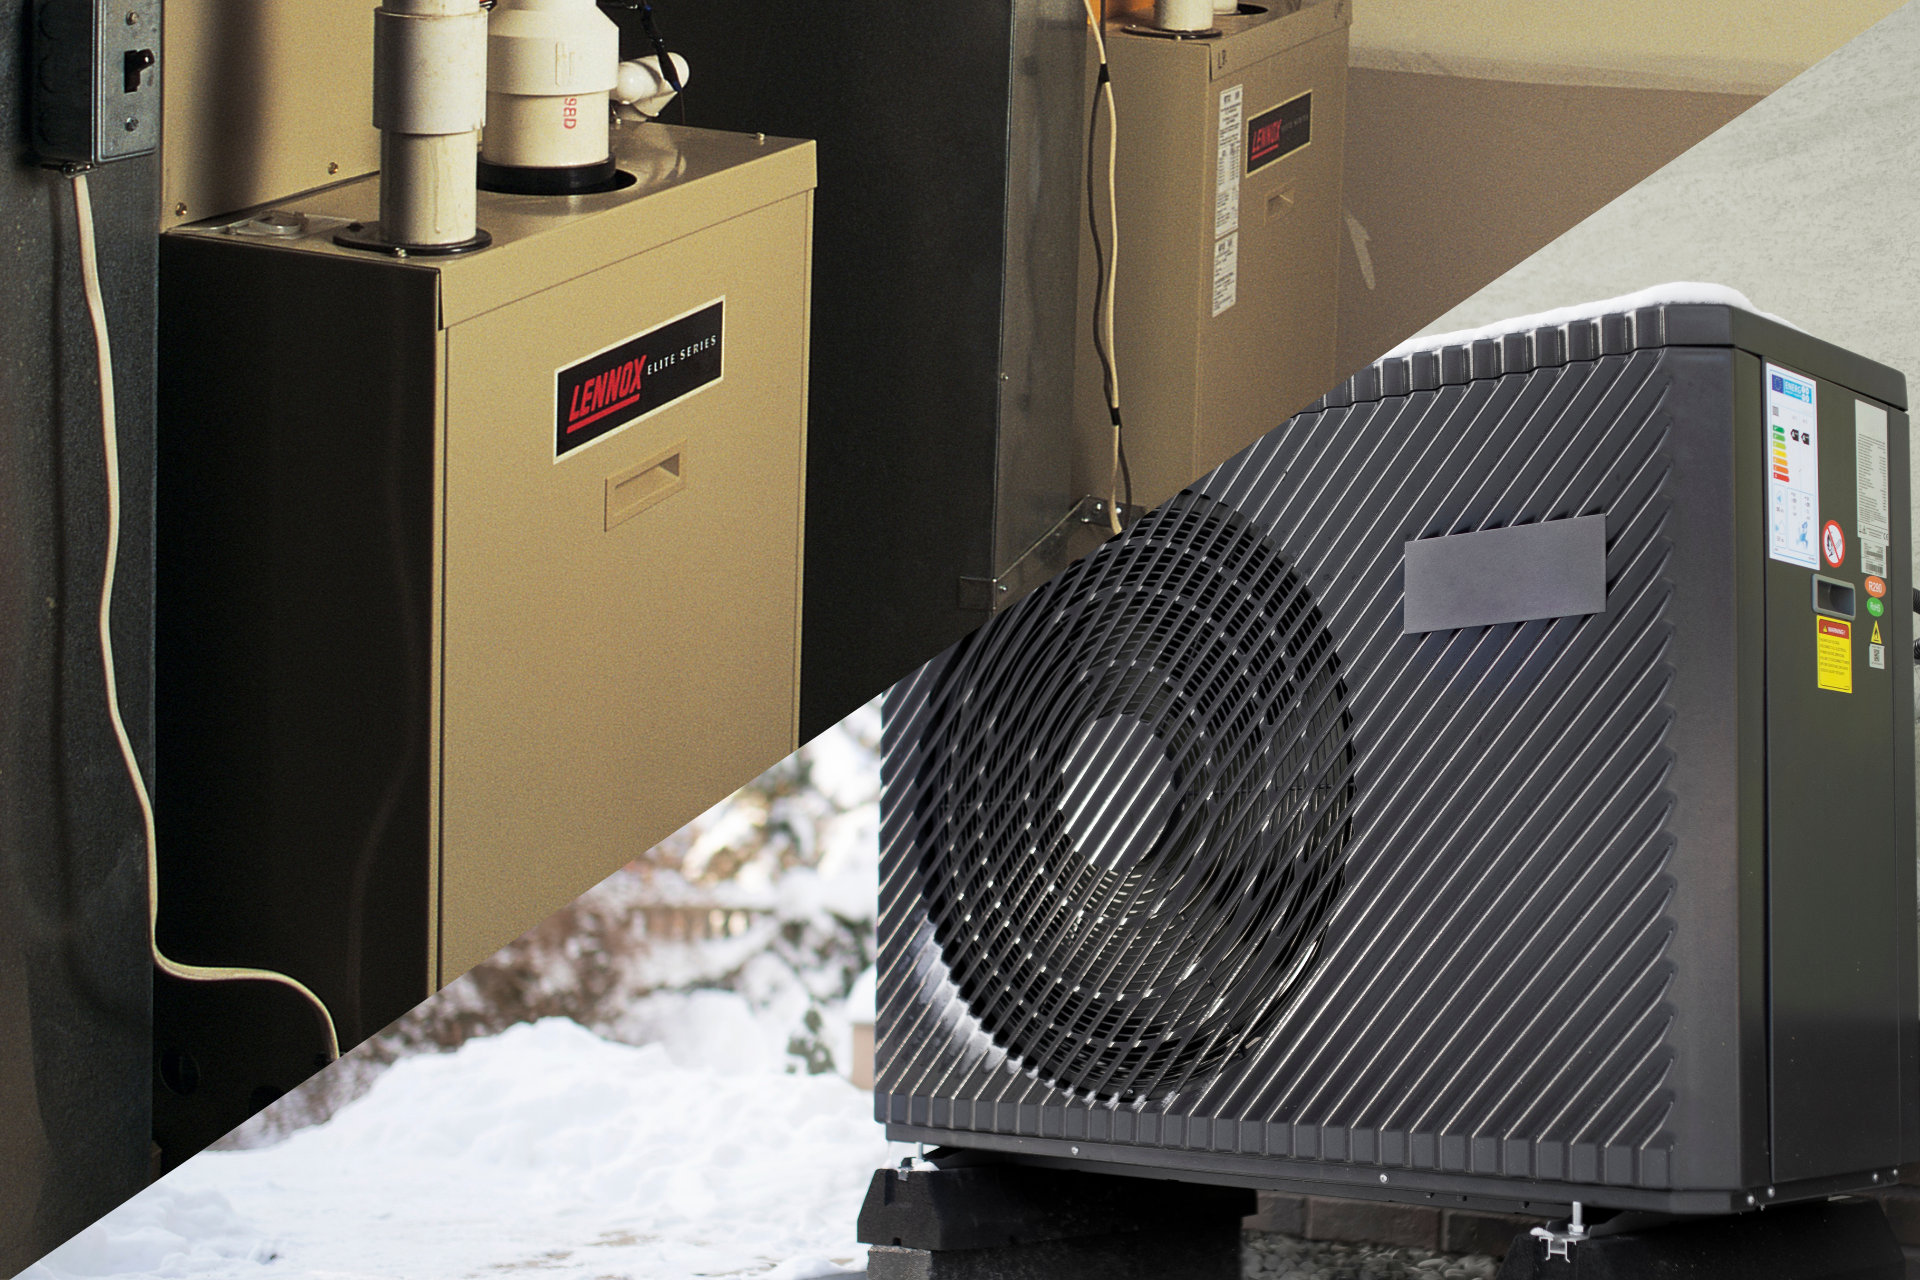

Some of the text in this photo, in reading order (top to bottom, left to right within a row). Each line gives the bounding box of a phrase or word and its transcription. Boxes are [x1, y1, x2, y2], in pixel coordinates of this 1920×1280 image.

[563, 98, 577, 129] 98D
[1251, 119, 1282, 154] LENNOX
[568, 335, 717, 422] LENNOX ELITE SERIES
[1868, 580, 1883, 593] R290
[1870, 601, 1881, 612] RoHS
